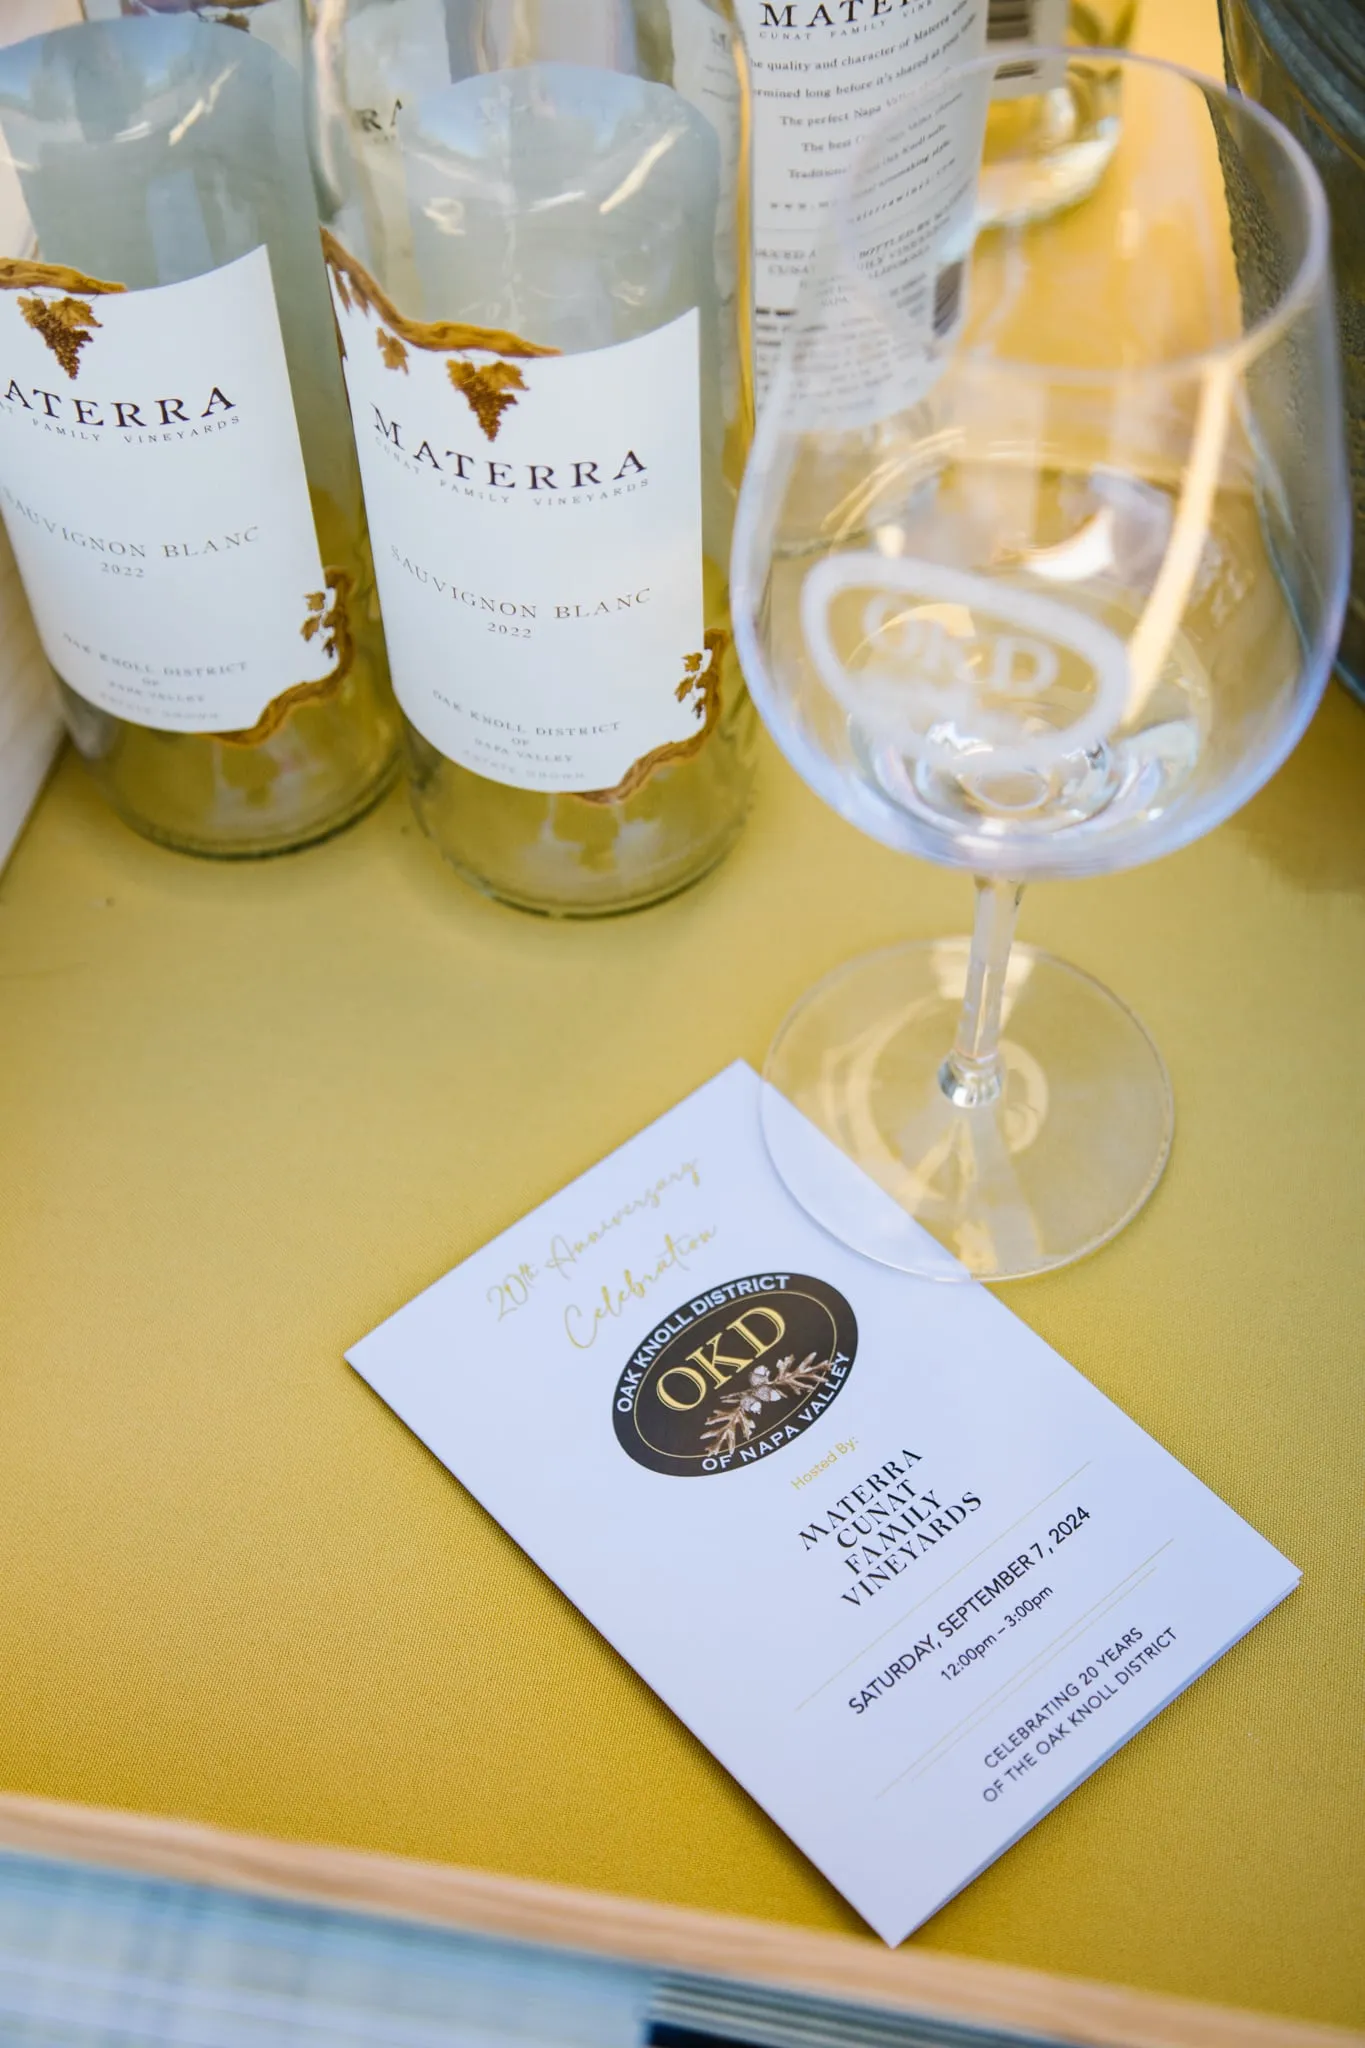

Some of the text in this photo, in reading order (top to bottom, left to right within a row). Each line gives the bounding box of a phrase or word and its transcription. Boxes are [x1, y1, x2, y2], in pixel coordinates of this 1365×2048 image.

[759, 18, 887, 41] CUNAT FAMILY
[760, 0, 908, 27] MATE
[767, 59, 810, 72] quality
[815, 57, 838, 69] and
[841, 46, 897, 67] character
[805, 87, 831, 100] long
[836, 79, 873, 96] before
[876, 71, 893, 86] it's
[780, 115, 802, 126] The
[807, 112, 849, 129] perfect
[801, 141, 824, 152] The
[788, 166, 849, 180] Tradition
[3, 379, 236, 428] ATERRA
[32, 415, 241, 444] FAMILY VINEYARDS
[369, 401, 648, 491] MATERRA
[439, 478, 511, 504] FAMILY
[532, 477, 649, 507] VINEYARDS
[100, 561, 145, 579] 2022
[161, 525, 259, 559] BLANC
[390, 543, 652, 620] SAUVIGNON BLANC
[486, 621, 533, 640] 2022
[163, 660, 248, 678] DISTRICT
[470, 708, 528, 735] KNOLL
[535, 720, 622, 737] DISTRICT
[544, 1157, 701, 1281] Anniversary
[564, 1224, 717, 1349] Celebration
[616, 1275, 791, 1413] OAK KNOLL DISTRICT
[656, 1306, 786, 1412] OKD
[702, 1351, 851, 1472] OF NAPA VALLEY
[790, 1435, 859, 1491] Hosted By:
[798, 1448, 924, 1551] MATERRA
[836, 1479, 918, 1549] CUNAT
[840, 1491, 982, 1609] VINEYARDS
[843, 1489, 944, 1576] FAMILY
[848, 1633, 943, 1715] SATURDAY,
[937, 1554, 1036, 1638] SEPTEMBER
[1048, 1505, 1091, 1546] 2024
[940, 1630, 998, 1682] 12:00pm
[1004, 1586, 1054, 1629] 3:00pm
[983, 1627, 1178, 1803] OF THE OAK KNOLL DISTRICT
[984, 1627, 1144, 1770] CELEBRATING 20 YEARS
